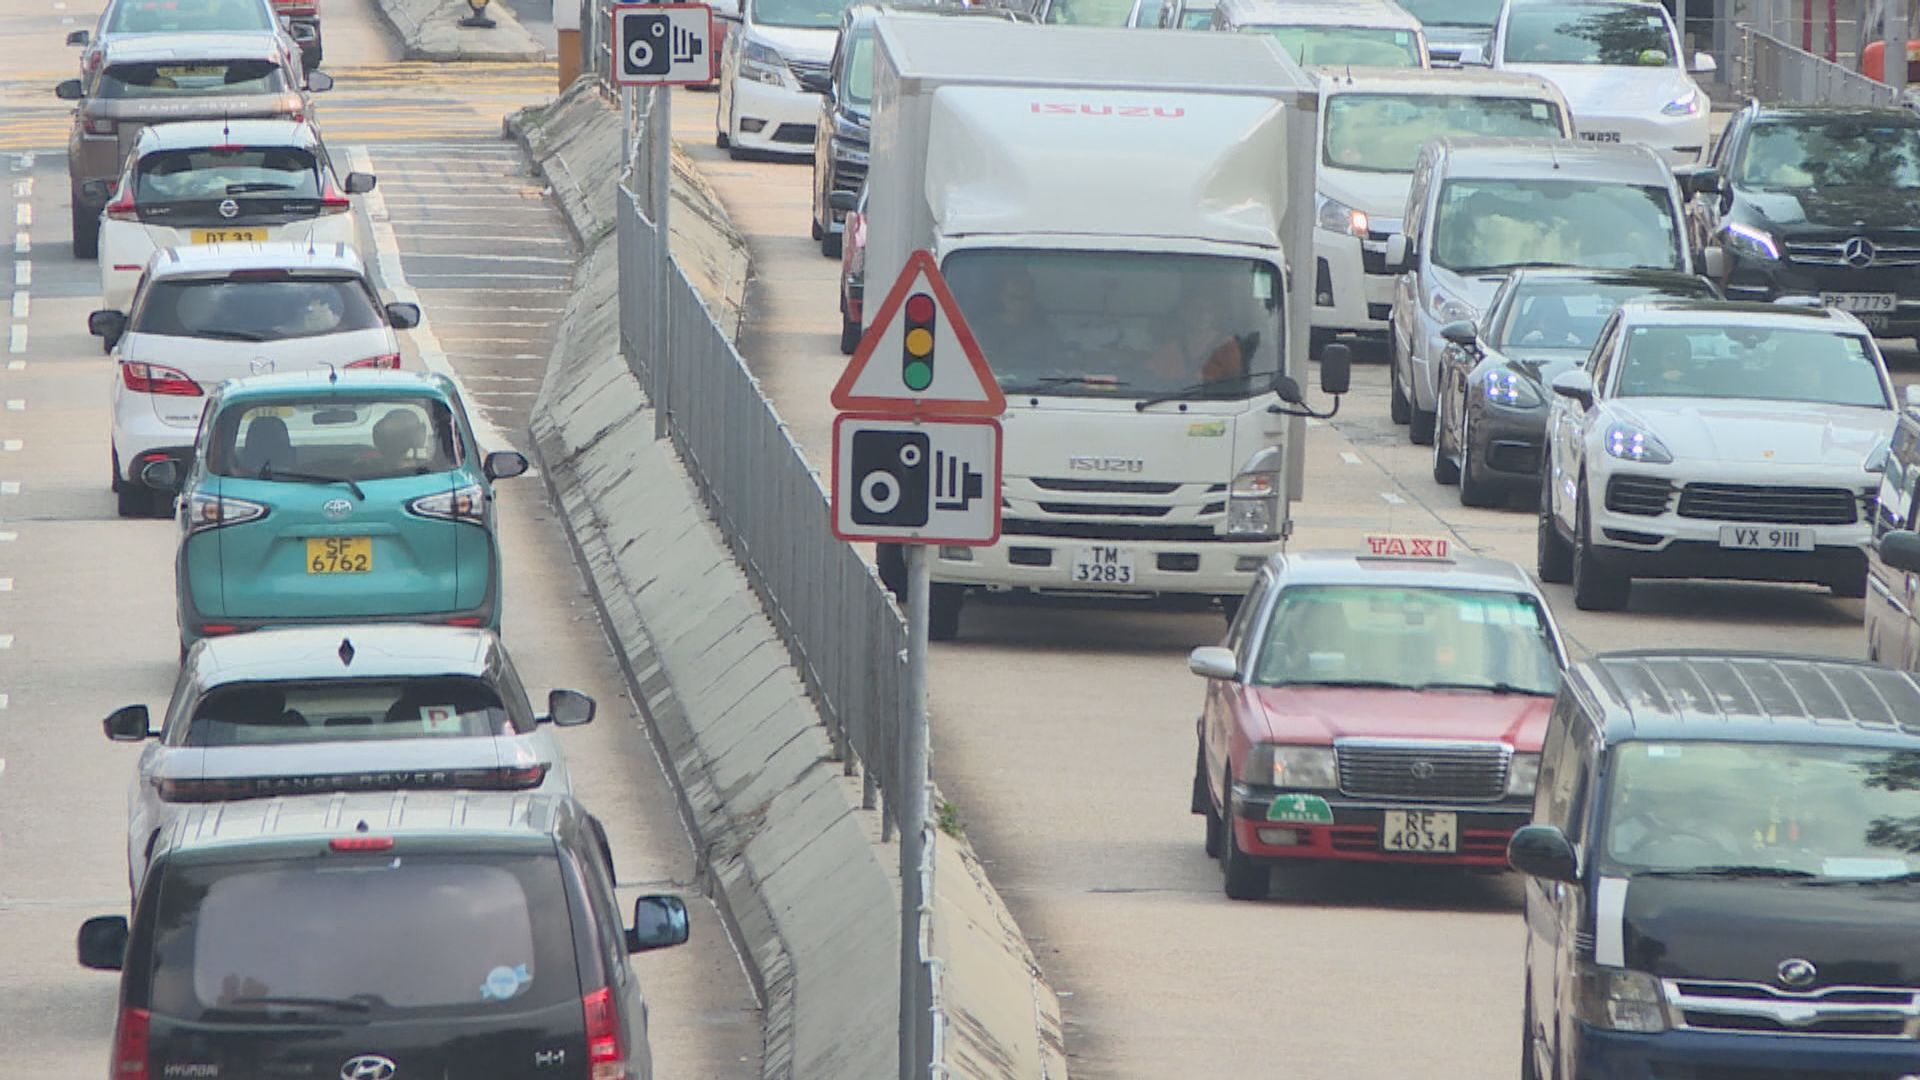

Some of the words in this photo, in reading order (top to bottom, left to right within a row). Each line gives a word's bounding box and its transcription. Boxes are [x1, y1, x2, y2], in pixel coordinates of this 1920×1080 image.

[1031, 103, 1185, 118] ISUZU
[1825, 296, 1845, 308] PP
[1849, 296, 1891, 309] 7779
[1070, 457, 1143, 473] ISUZU
[326, 538, 352, 555] SF
[1735, 528, 1759, 545] VX
[1769, 530, 1799, 547] 9111
[1091, 546, 1118, 564] TM
[1367, 537, 1447, 557] TAXI
[312, 553, 368, 572] 6762
[1077, 564, 1130, 583] 3283
[428, 709, 449, 728] P
[256, 776, 344, 789] RANGE
[359, 772, 446, 785] ROVER
[1391, 832, 1450, 850] 4034
[164, 1063, 219, 1077] HYUNDAI
